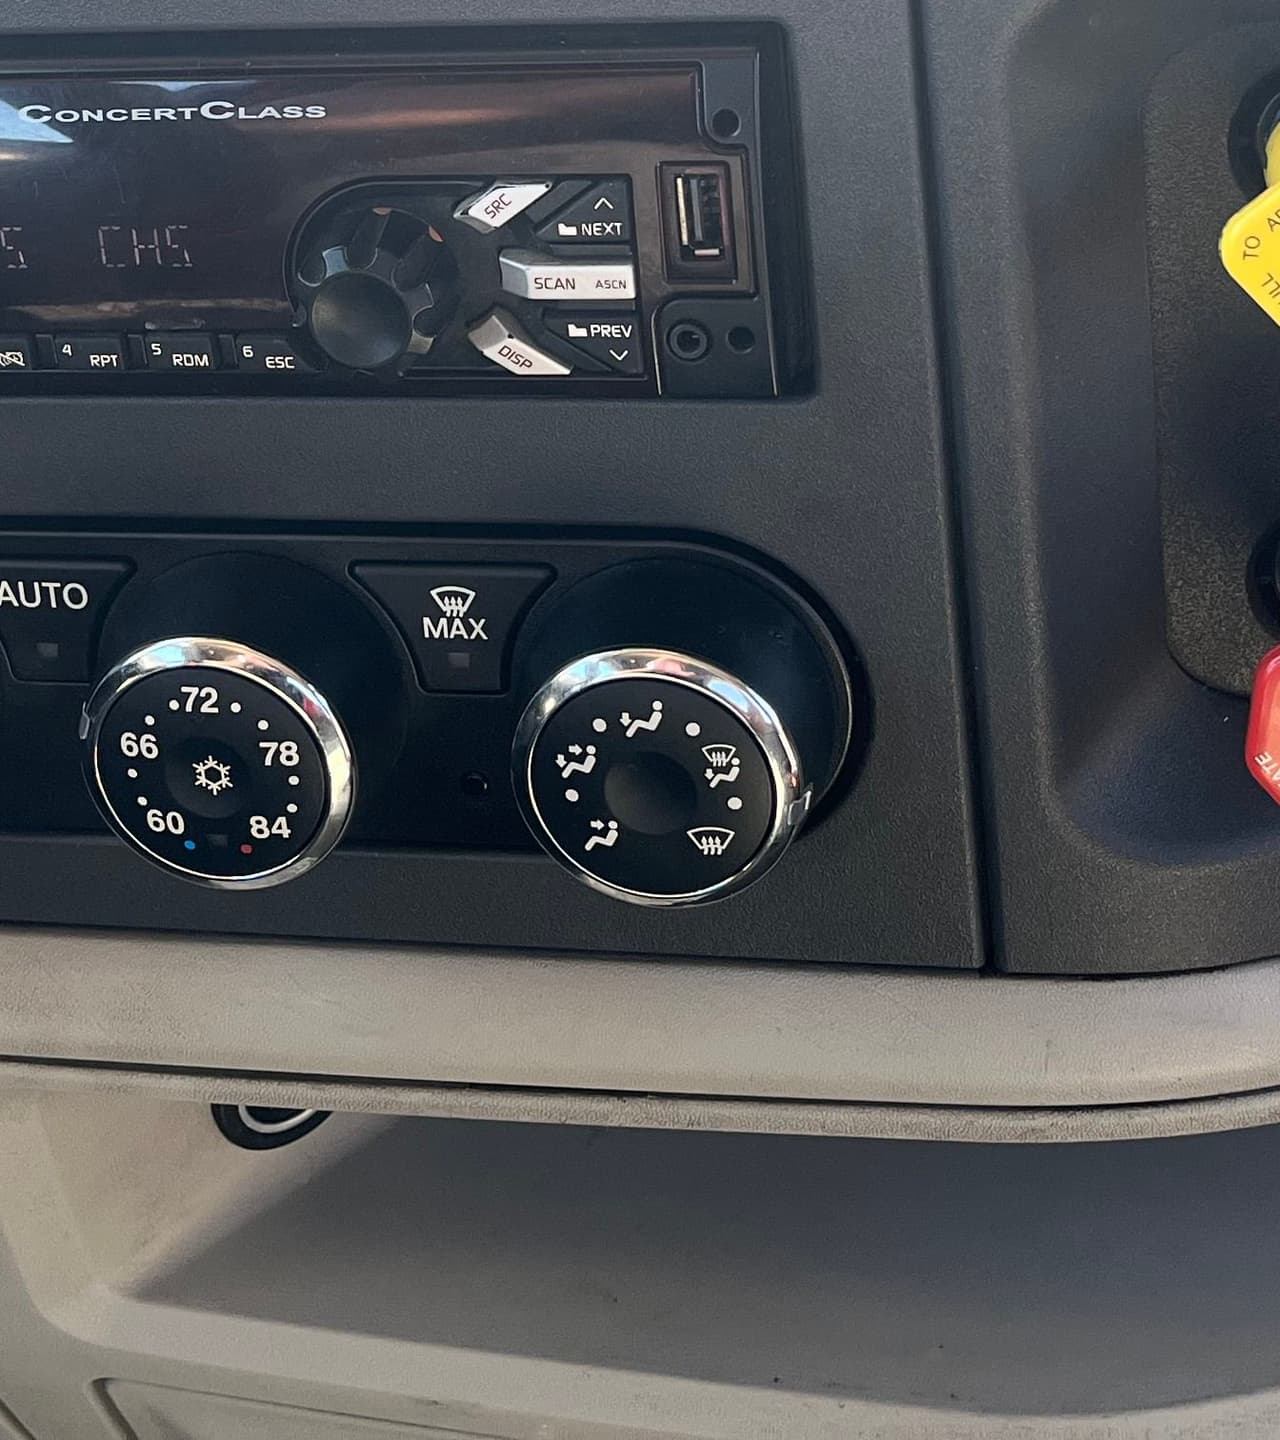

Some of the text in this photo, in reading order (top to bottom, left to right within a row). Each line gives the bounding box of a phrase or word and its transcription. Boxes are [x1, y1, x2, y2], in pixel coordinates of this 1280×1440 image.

[484, 193, 513, 221] SRC
[581, 222, 623, 237] NEXT
[1243, 235, 1261, 260] TO
[534, 276, 576, 291] SCAN
[594, 278, 627, 291] ASCN
[589, 323, 632, 338] PREV
[62, 344, 73, 357] 4
[151, 342, 162, 356] 5
[242, 345, 253, 358] 6
[90, 354, 118, 368] RPT
[172, 354, 209, 368] RDM
[265, 355, 295, 370] ESC
[497, 345, 533, 371] DISP
[422, 616, 489, 640] MAX
[180, 686, 219, 713] 72
[120, 731, 159, 759] 66
[259, 740, 300, 766] 78
[146, 808, 185, 835] 60
[249, 815, 291, 839] 84
